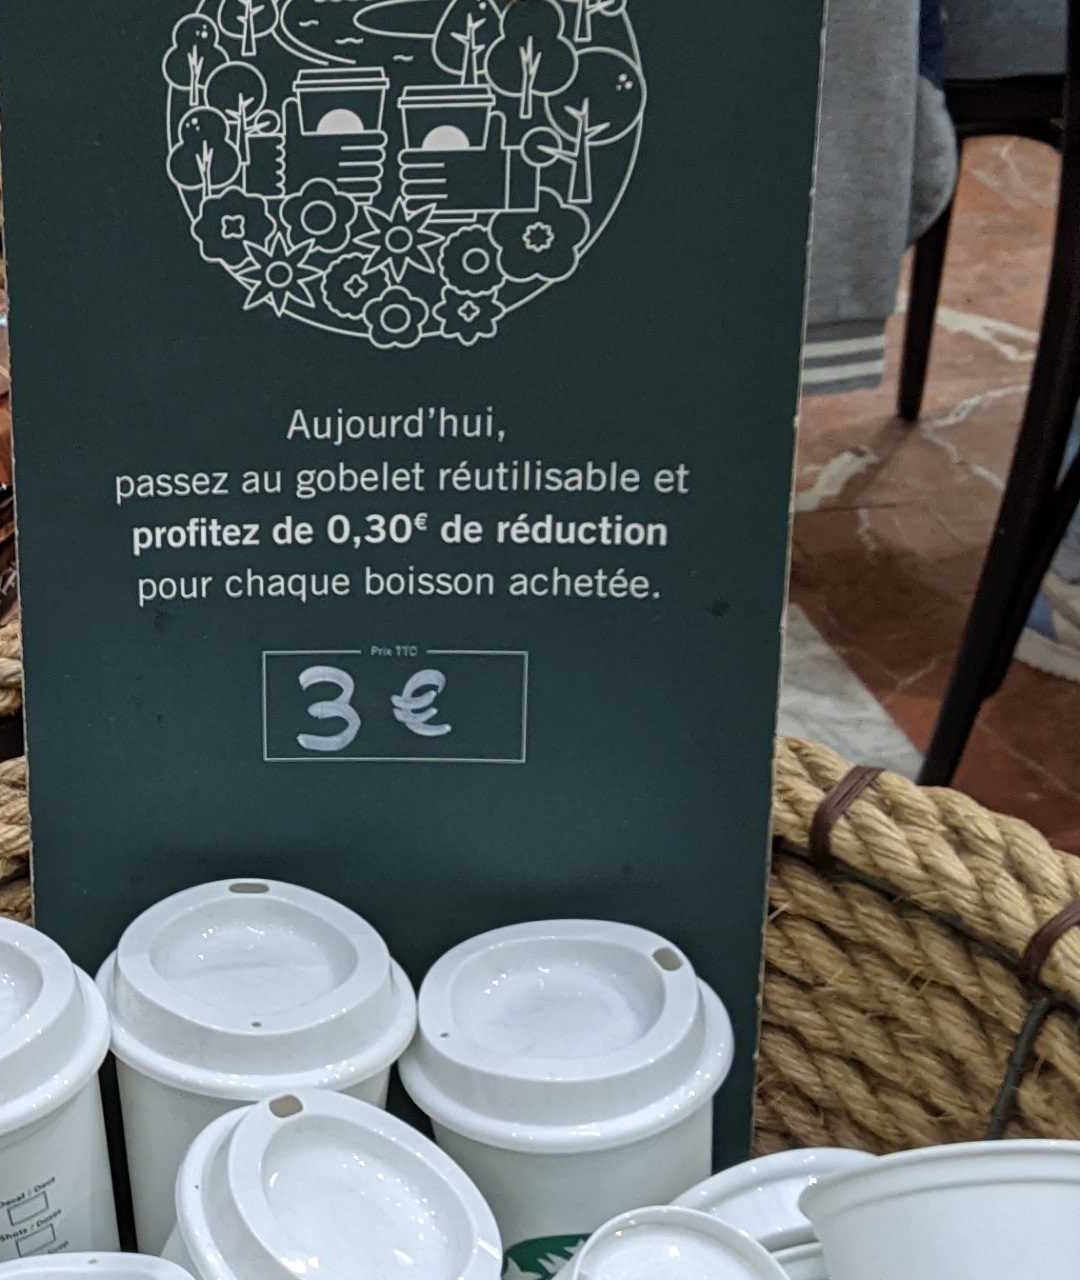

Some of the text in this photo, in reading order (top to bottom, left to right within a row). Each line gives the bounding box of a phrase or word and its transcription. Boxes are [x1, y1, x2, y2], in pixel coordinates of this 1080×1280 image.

[286, 406, 506, 446] Aujourd'hui,
[115, 460, 690, 505] passez au gobelet réutilisable et
[132, 512, 668, 557] profitez de 0,30€ de réduction
[138, 566, 661, 607] pour chaque boisson achetée.
[297, 665, 452, 752] 3 €
